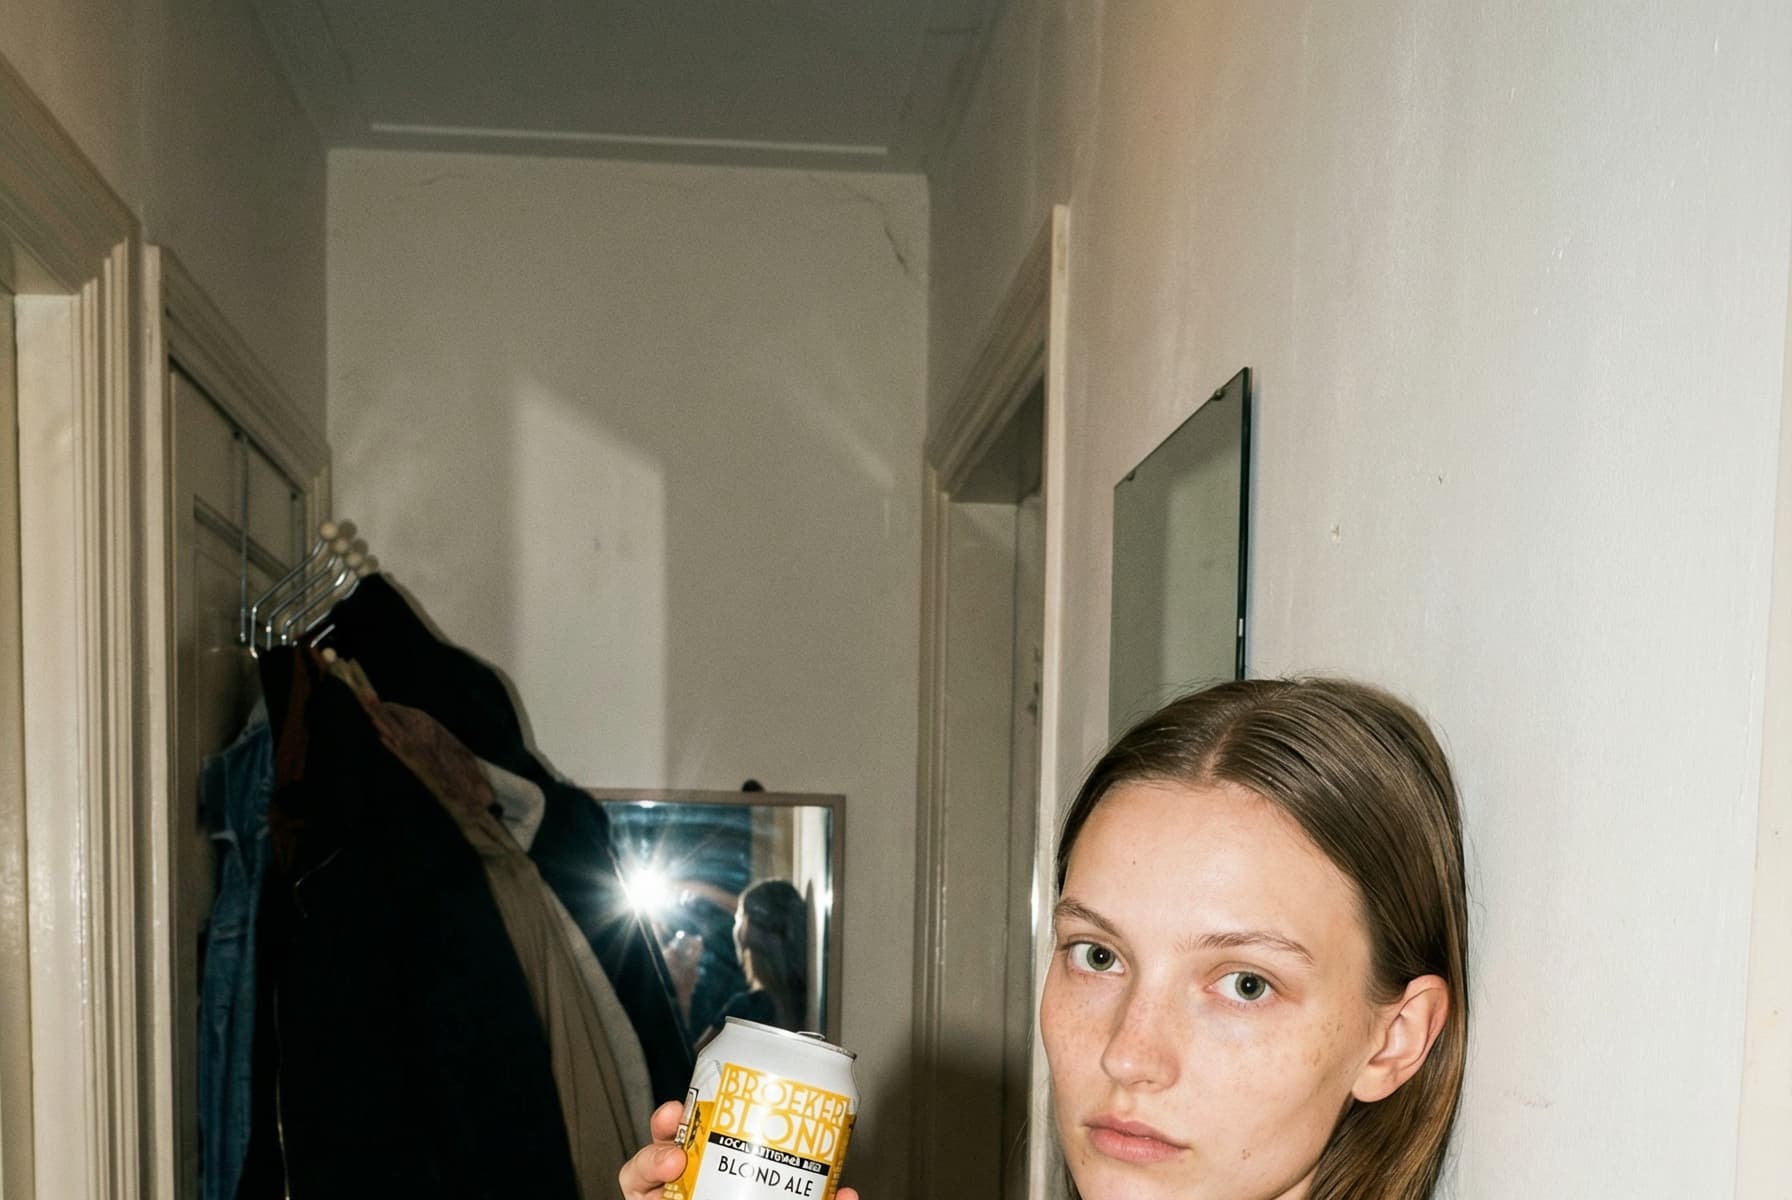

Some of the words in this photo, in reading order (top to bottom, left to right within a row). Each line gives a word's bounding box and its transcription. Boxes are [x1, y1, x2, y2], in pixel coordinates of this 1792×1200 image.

[712, 1094, 841, 1162] BLOND
[720, 1066, 849, 1128] BROEKER
[718, 1155, 781, 1187] BLOND
[784, 1176, 814, 1198] ALE
